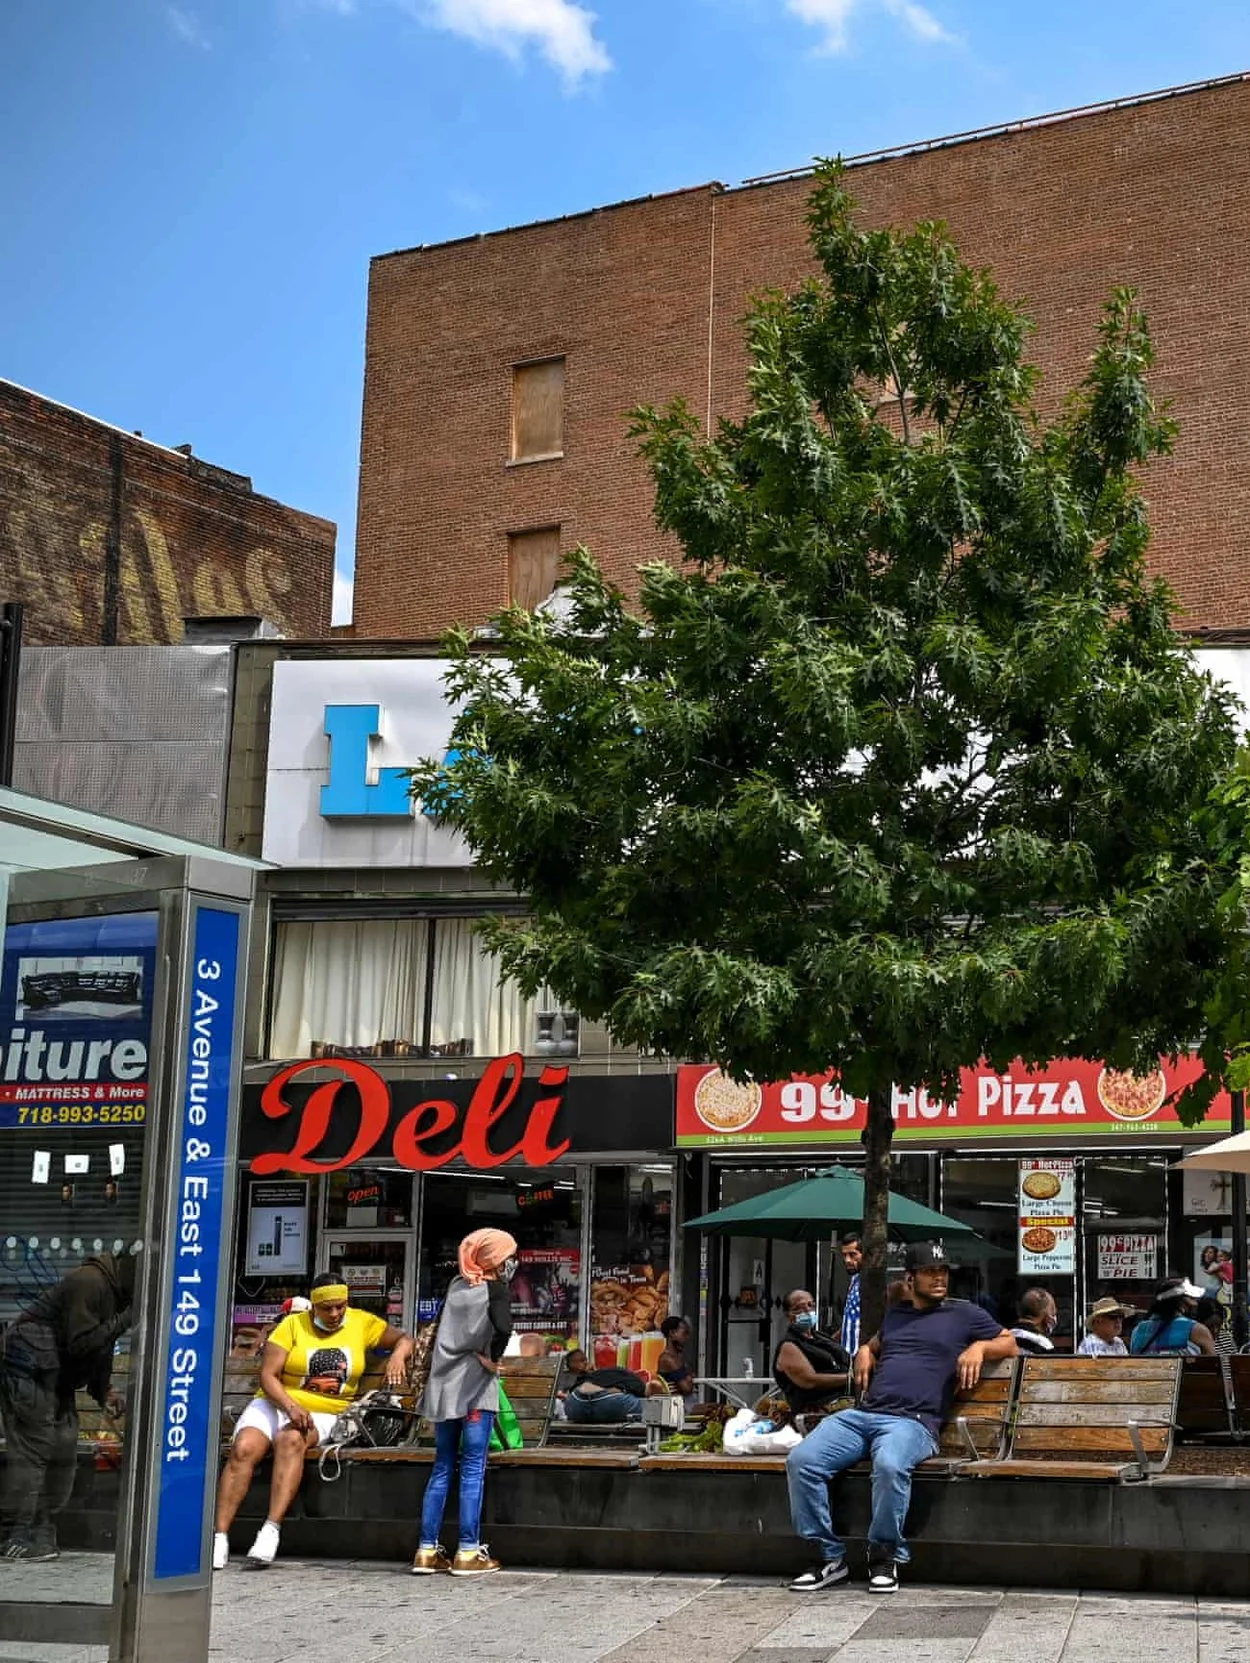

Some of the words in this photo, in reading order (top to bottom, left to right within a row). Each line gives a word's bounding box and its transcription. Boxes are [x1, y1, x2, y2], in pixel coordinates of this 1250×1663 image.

[197, 958, 221, 980] 3
[0, 1029, 147, 1080] iture
[188, 989, 220, 1126] Avenue
[15, 1087, 90, 1100] MATTRESS
[94, 1087, 105, 1098] &
[109, 1086, 145, 1098] More
[977, 1075, 1087, 1117] Pizza
[18, 1104, 146, 1124] 718-993-5250
[250, 1052, 571, 1175] Deli
[186, 1137, 212, 1163] &
[180, 1176, 209, 1257] East
[1101, 1256, 1139, 1265] SLICE
[1124, 1236, 1154, 1252] PIZZA
[1113, 1268, 1138, 1278] PIE
[174, 1269, 202, 1337] 149
[166, 1348, 197, 1462] Street
